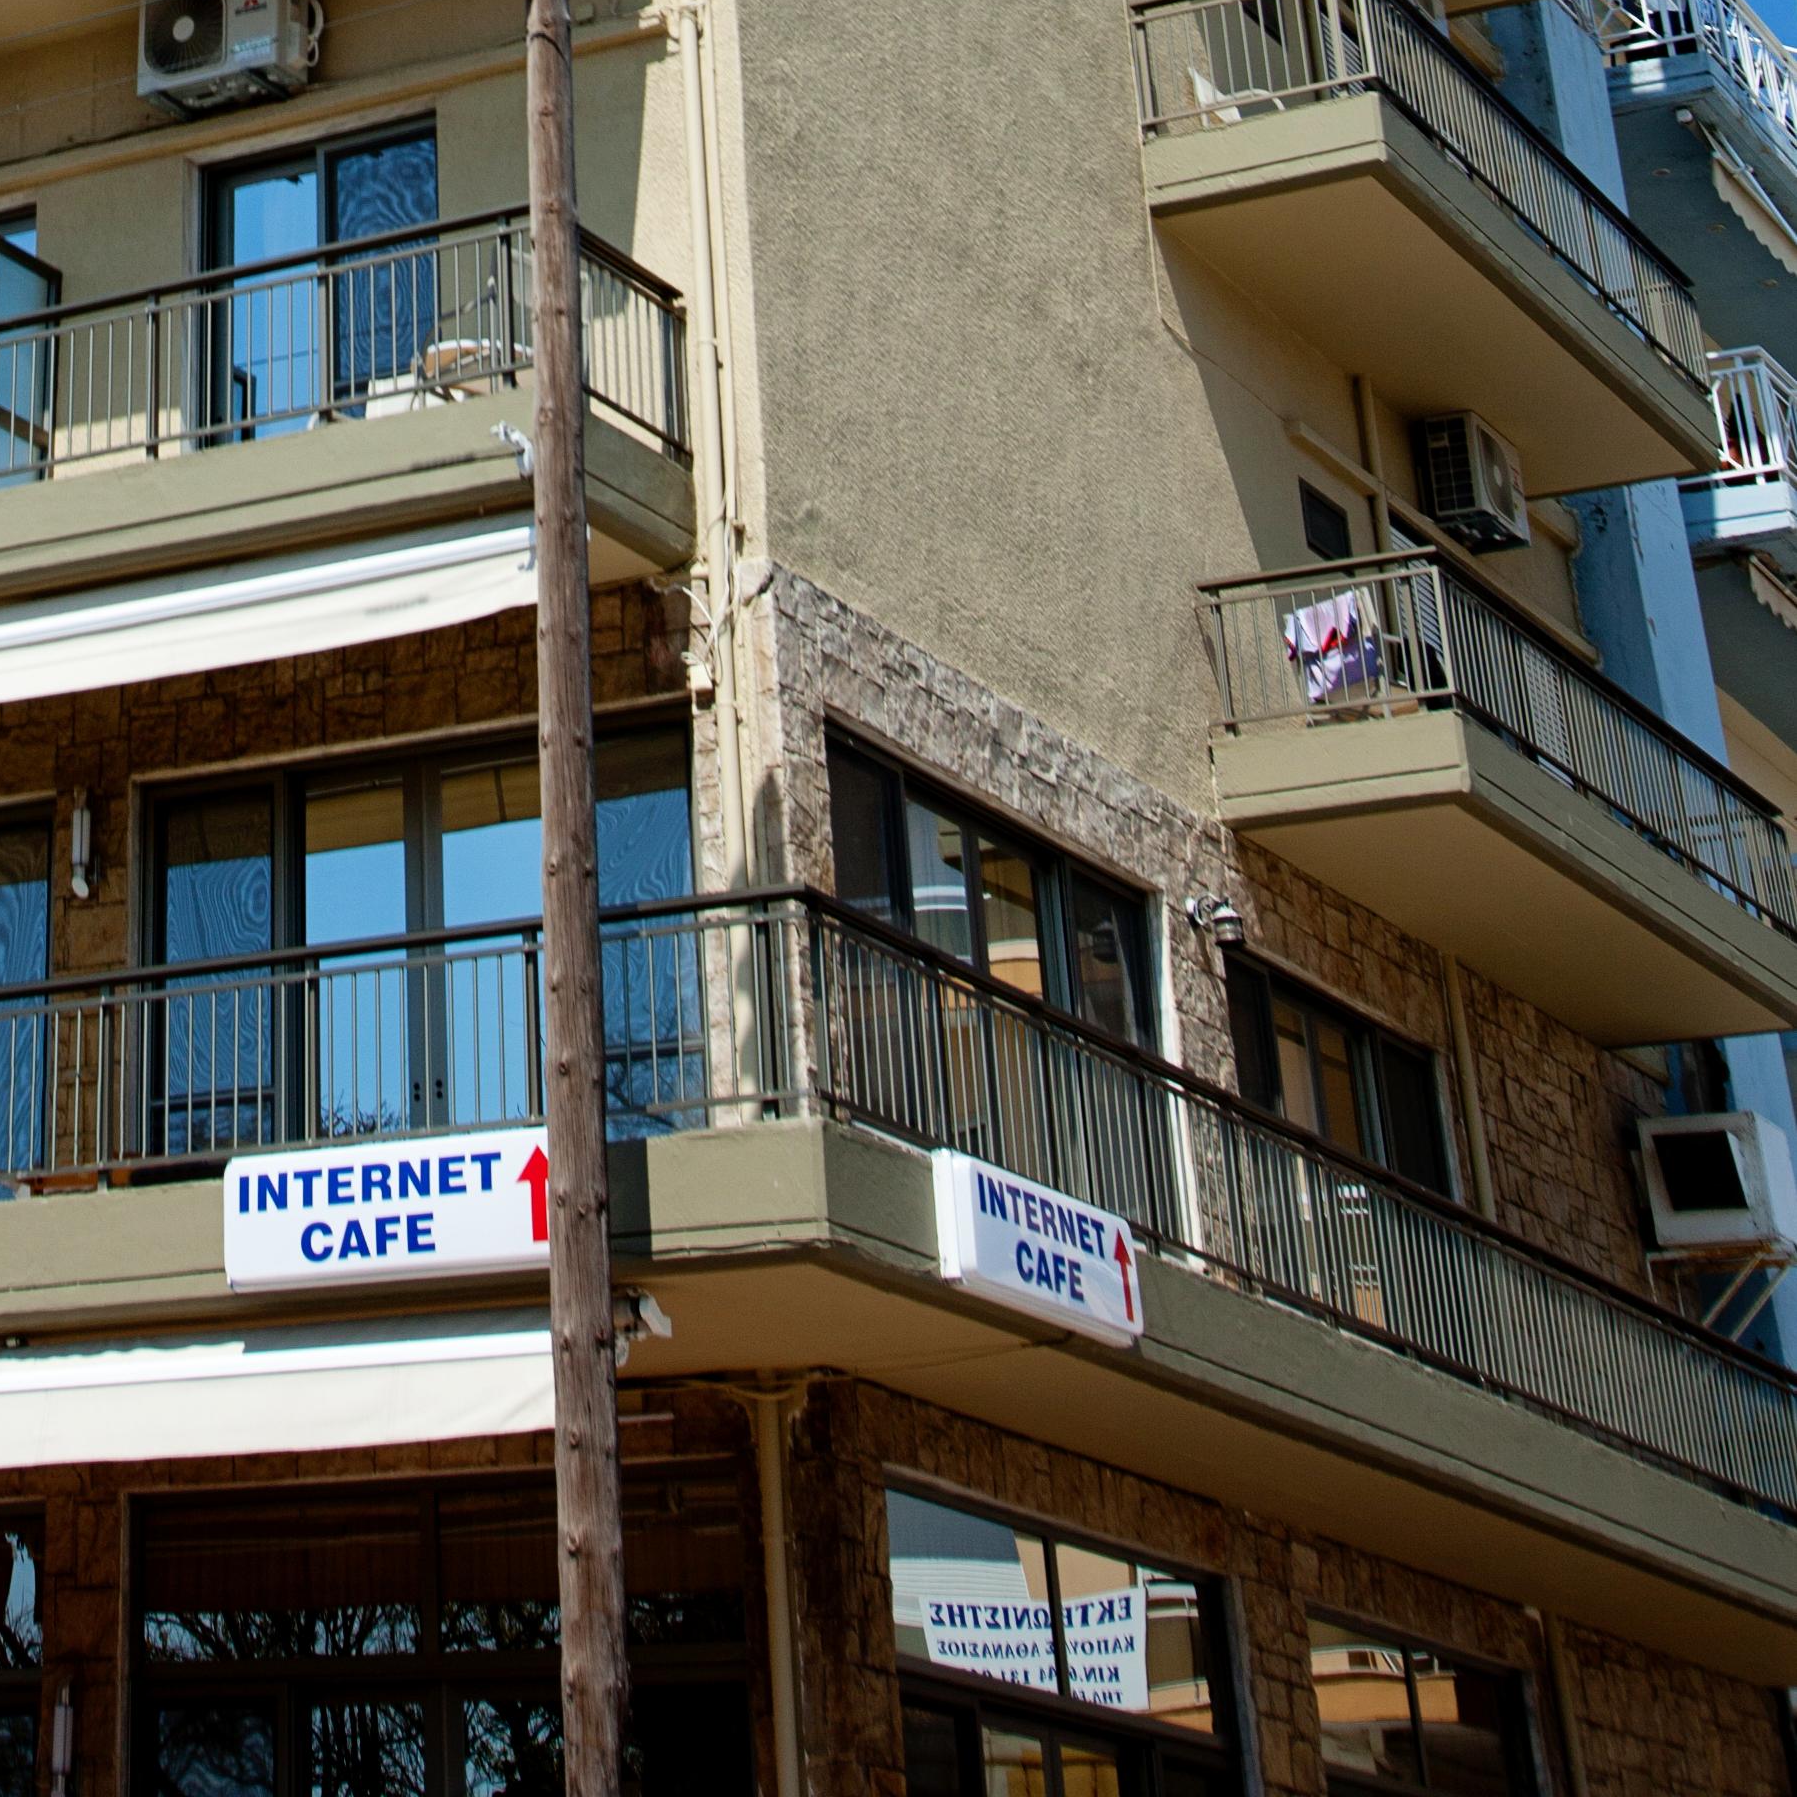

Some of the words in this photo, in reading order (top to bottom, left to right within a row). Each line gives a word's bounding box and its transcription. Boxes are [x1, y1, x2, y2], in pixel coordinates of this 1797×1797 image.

[238, 1151, 502, 1214] INTERNET
[300, 1212, 437, 1263] CAFE
[976, 1171, 1106, 1260] INTERNET
[1015, 1239, 1085, 1303] CAFE
